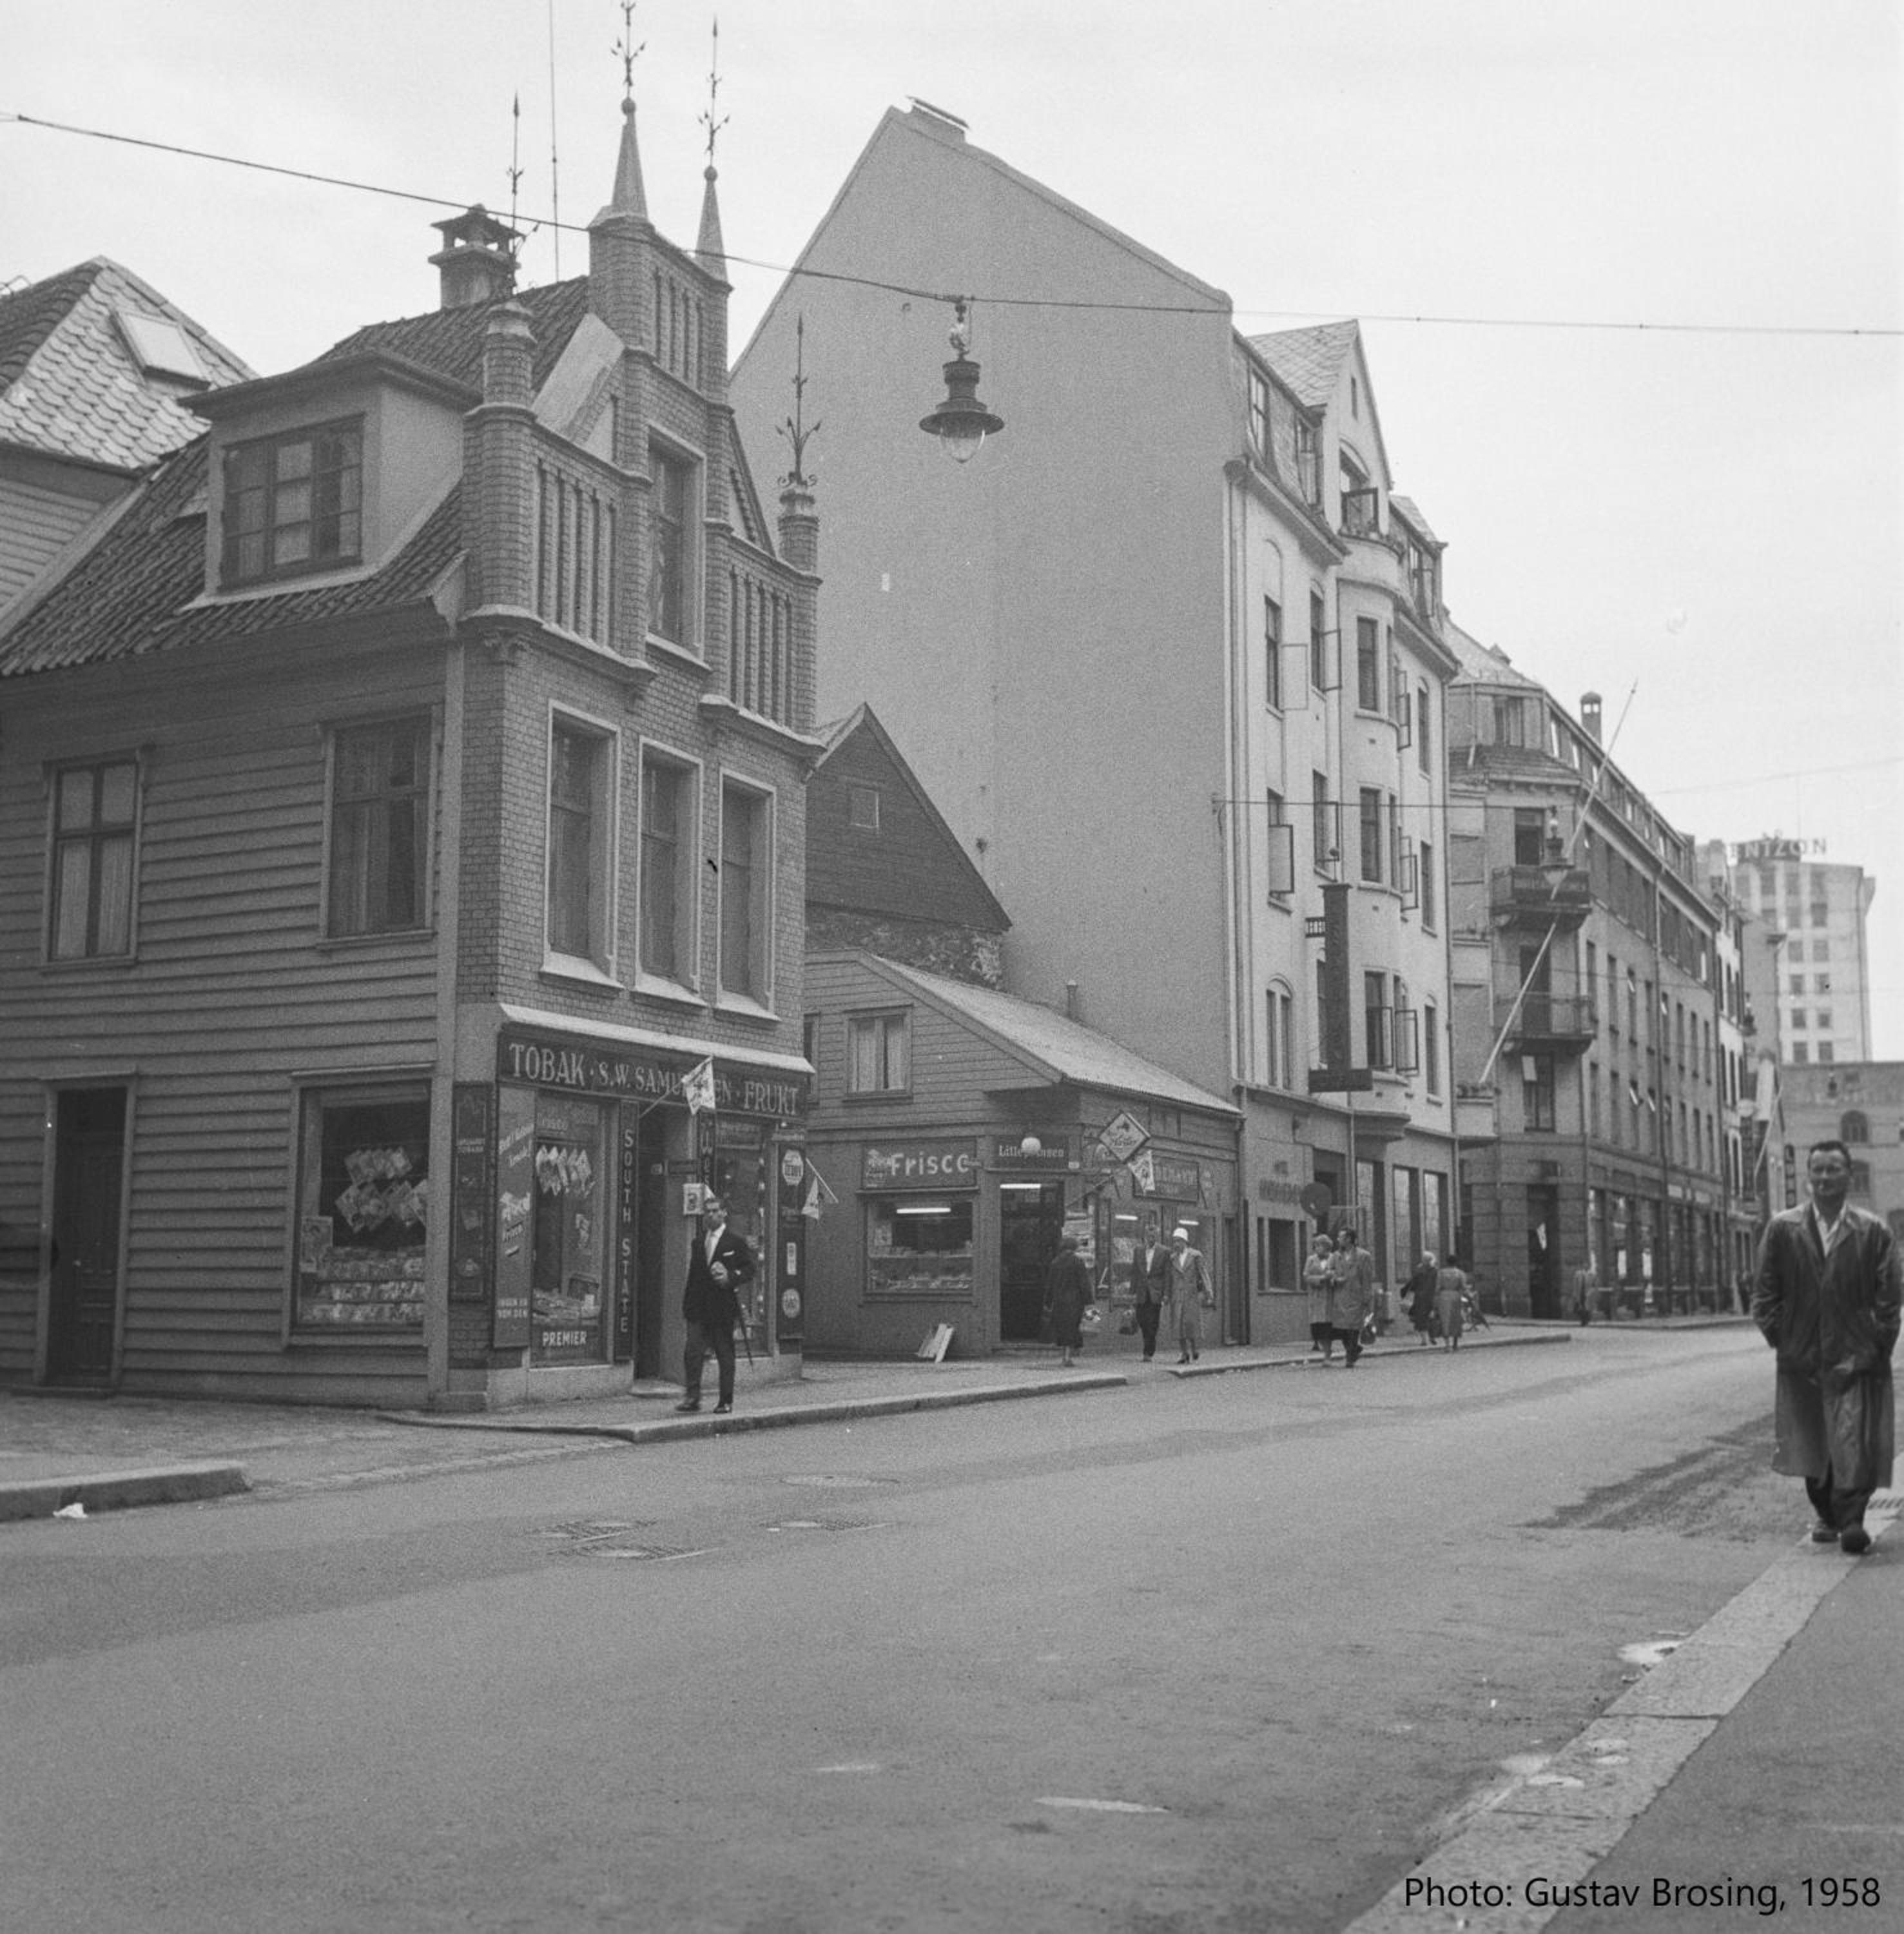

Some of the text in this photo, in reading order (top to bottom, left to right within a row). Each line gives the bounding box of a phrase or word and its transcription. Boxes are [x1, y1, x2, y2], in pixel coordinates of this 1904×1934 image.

[509, 1042, 585, 1086] TOBAK
[744, 1081, 799, 1115] FRUKT
[620, 1128, 634, 1333] SOUTH STATE
[542, 1330, 587, 1347] PREMIER
